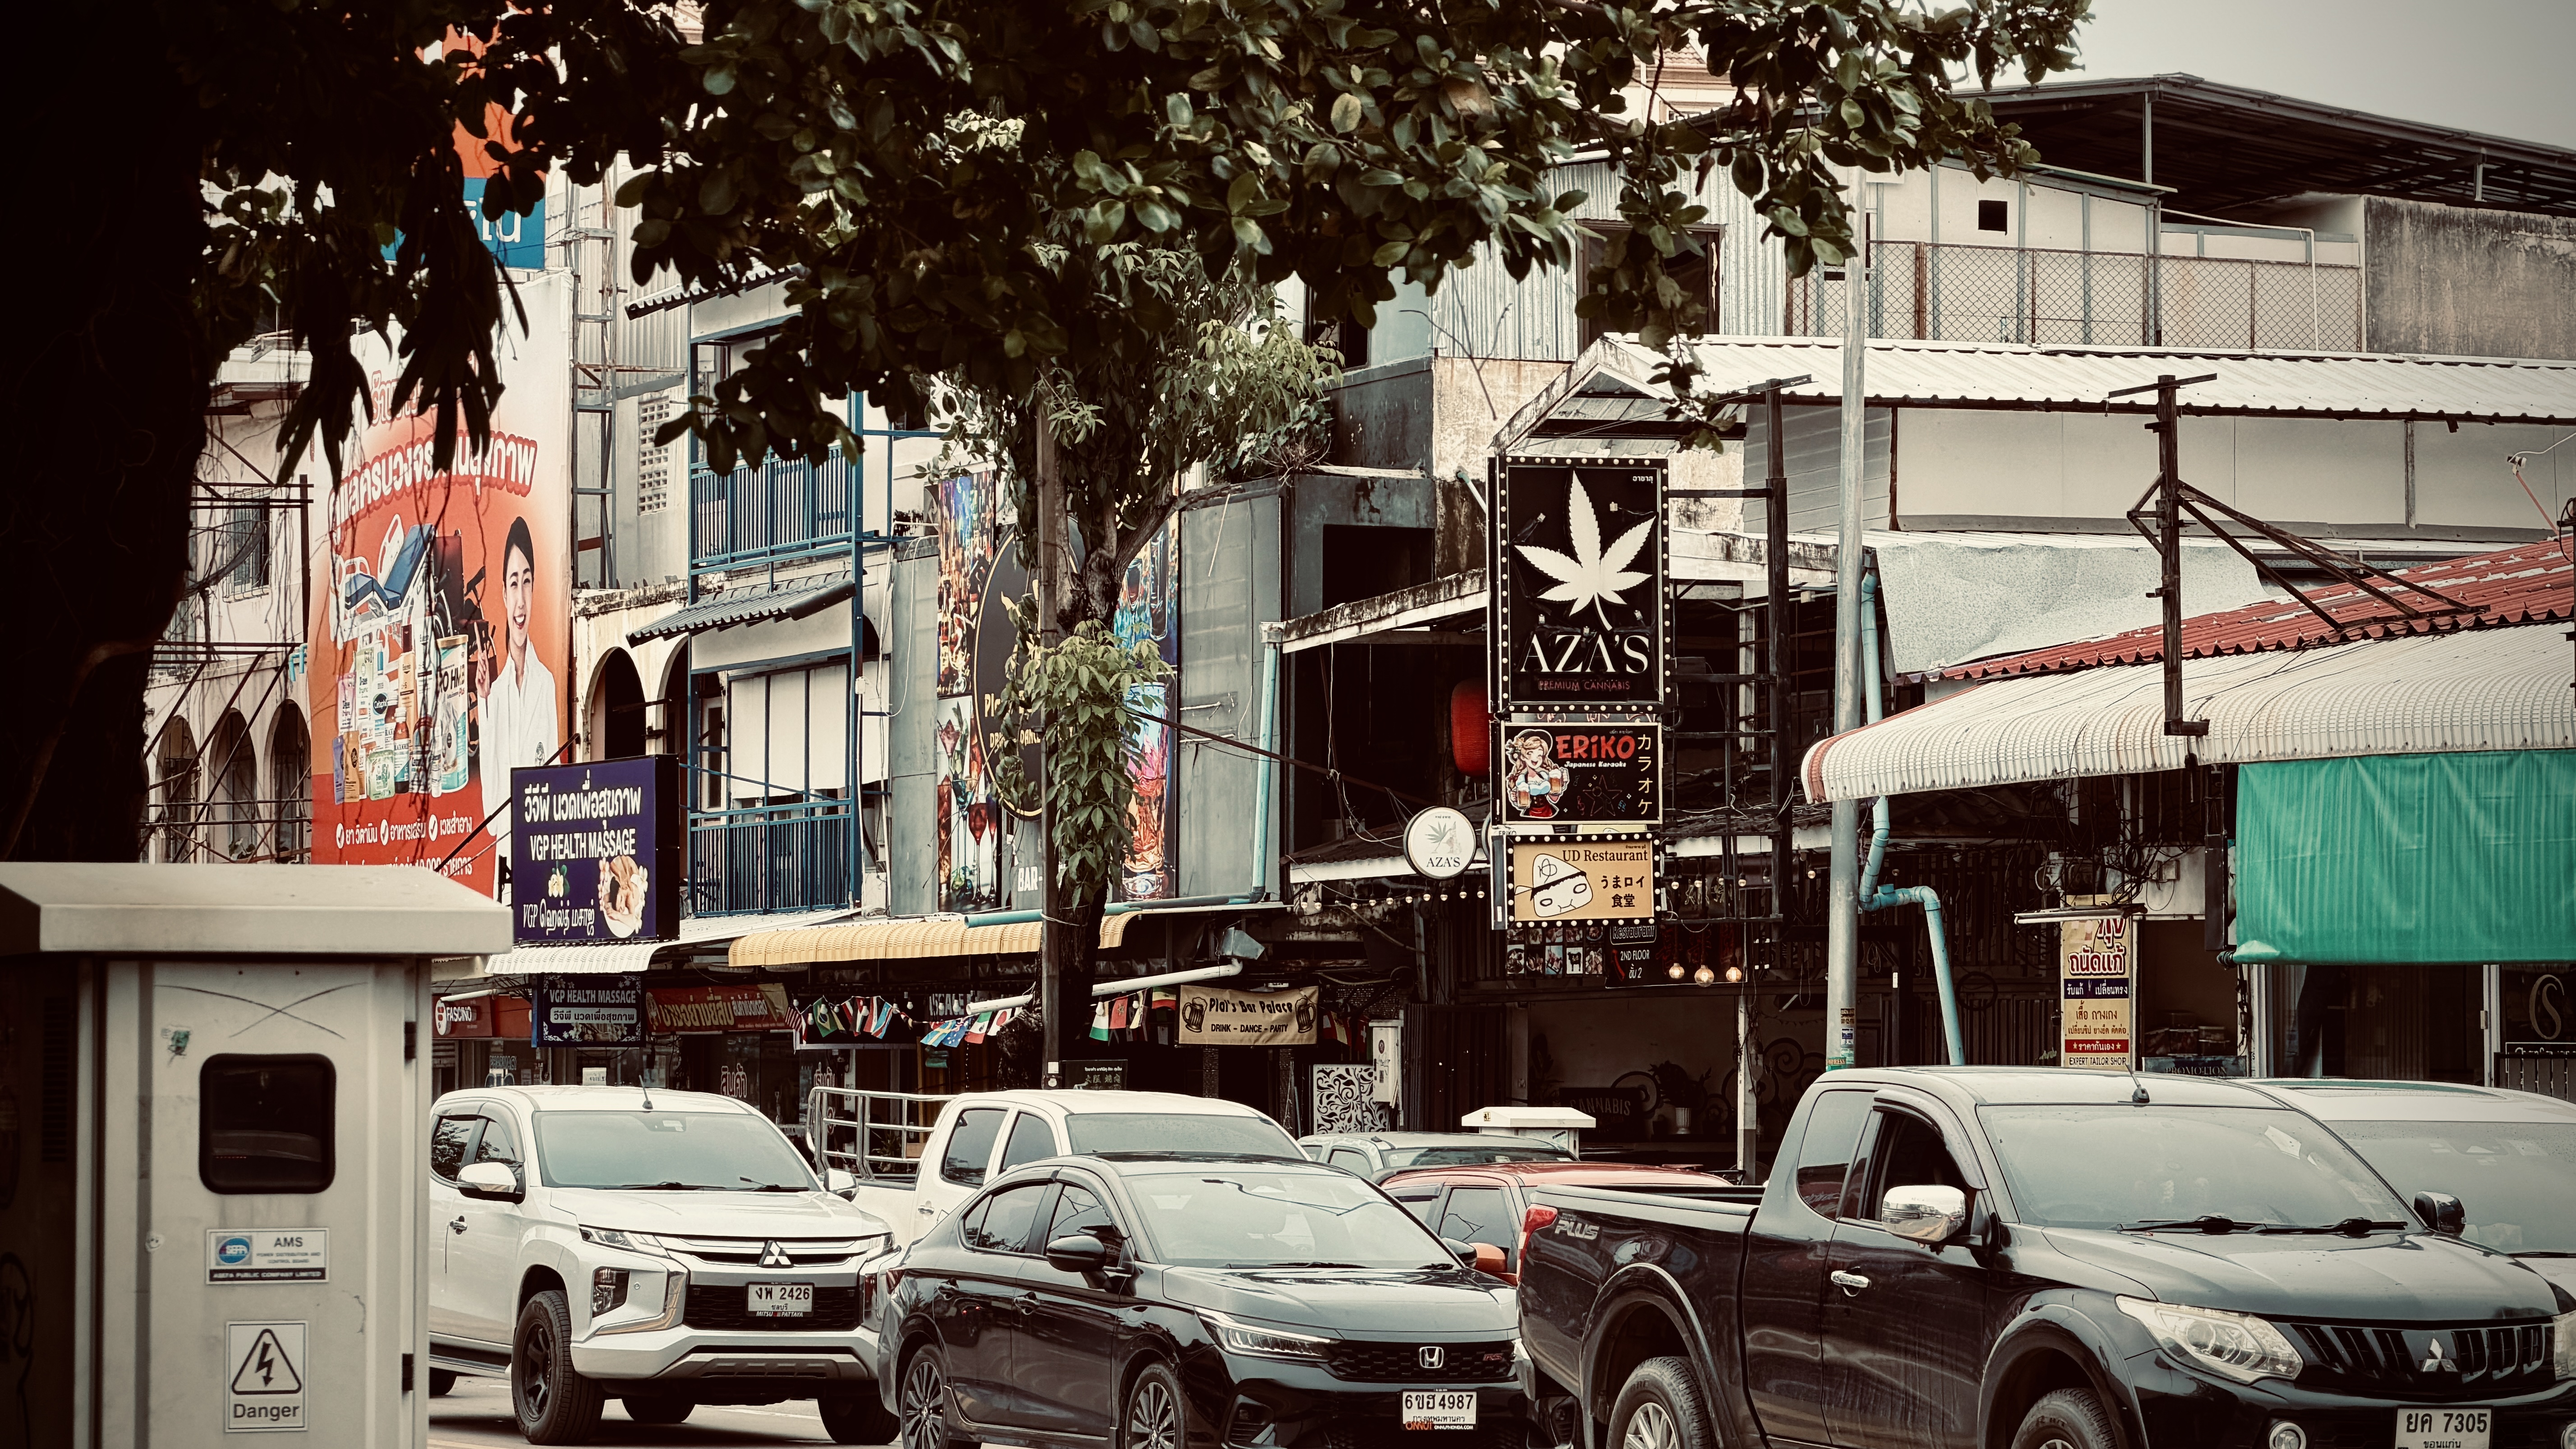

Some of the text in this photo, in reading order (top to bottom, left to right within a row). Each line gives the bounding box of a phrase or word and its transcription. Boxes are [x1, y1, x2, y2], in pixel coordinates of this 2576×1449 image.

[1520, 634, 1649, 674] AZA'S
[1538, 679, 1631, 690] PREMIUM CANNABIS
[1638, 734, 1653, 815] カラオケ
[553, 769, 641, 830] นวดเพื่อสุขภาพ
[345, 810, 473, 845] ยา วิตามิน อาหารเสริม เวชสำอาง
[530, 828, 636, 860] VGP HEALTH MASSAGE
[1426, 857, 1461, 867] AZA'S
[1563, 850, 1648, 862] UD Restaurant
[1601, 875, 1645, 889] うまロイ
[1612, 893, 1635, 908] 食堂
[523, 903, 538, 929] VGP
[1613, 925, 1655, 939] Restaurant
[1620, 949, 1650, 961] 2ND FLOOR
[2068, 942, 2126, 975] ถนัดแก้
[1638, 967, 1642, 979] 2
[2067, 980, 2128, 995] รับแก้ เปลี่ยนทรง
[550, 989, 636, 1003] VGP HEALTH MASSAGE
[1238, 1001, 1256, 1013] Bar
[1259, 1000, 1293, 1013] Palace
[2076, 999, 2117, 1020] เสื้อ กางเกง
[446, 1006, 472, 1022] FASCINO
[553, 1008, 635, 1023] วีจีพี นวดเพื่อสุขภาพ
[1211, 1024, 1231, 1032] DRINK
[1240, 1024, 1262, 1033] DANCE
[1270, 1024, 1288, 1032] PARTY
[2079, 1041, 2115, 1051] ราคากันเอง
[2069, 1057, 2127, 1066] EXPERT TAILOR SHOP
[2165, 1066, 2227, 1076] PROMOTION
[1570, 1097, 1631, 1116] CANNABIS
[1555, 1220, 1600, 1240] PLUS
[274, 1237, 303, 1247] AMS
[779, 1287, 810, 1300] 2426
[1439, 1394, 1474, 1410] 4987
[234, 1403, 300, 1421] Danger
[1405, 1421, 1432, 1431] ONNUT
[2406, 1412, 2488, 1433] ยค 7305
[2423, 1438, 2461, 1449] ขอนแก่น
